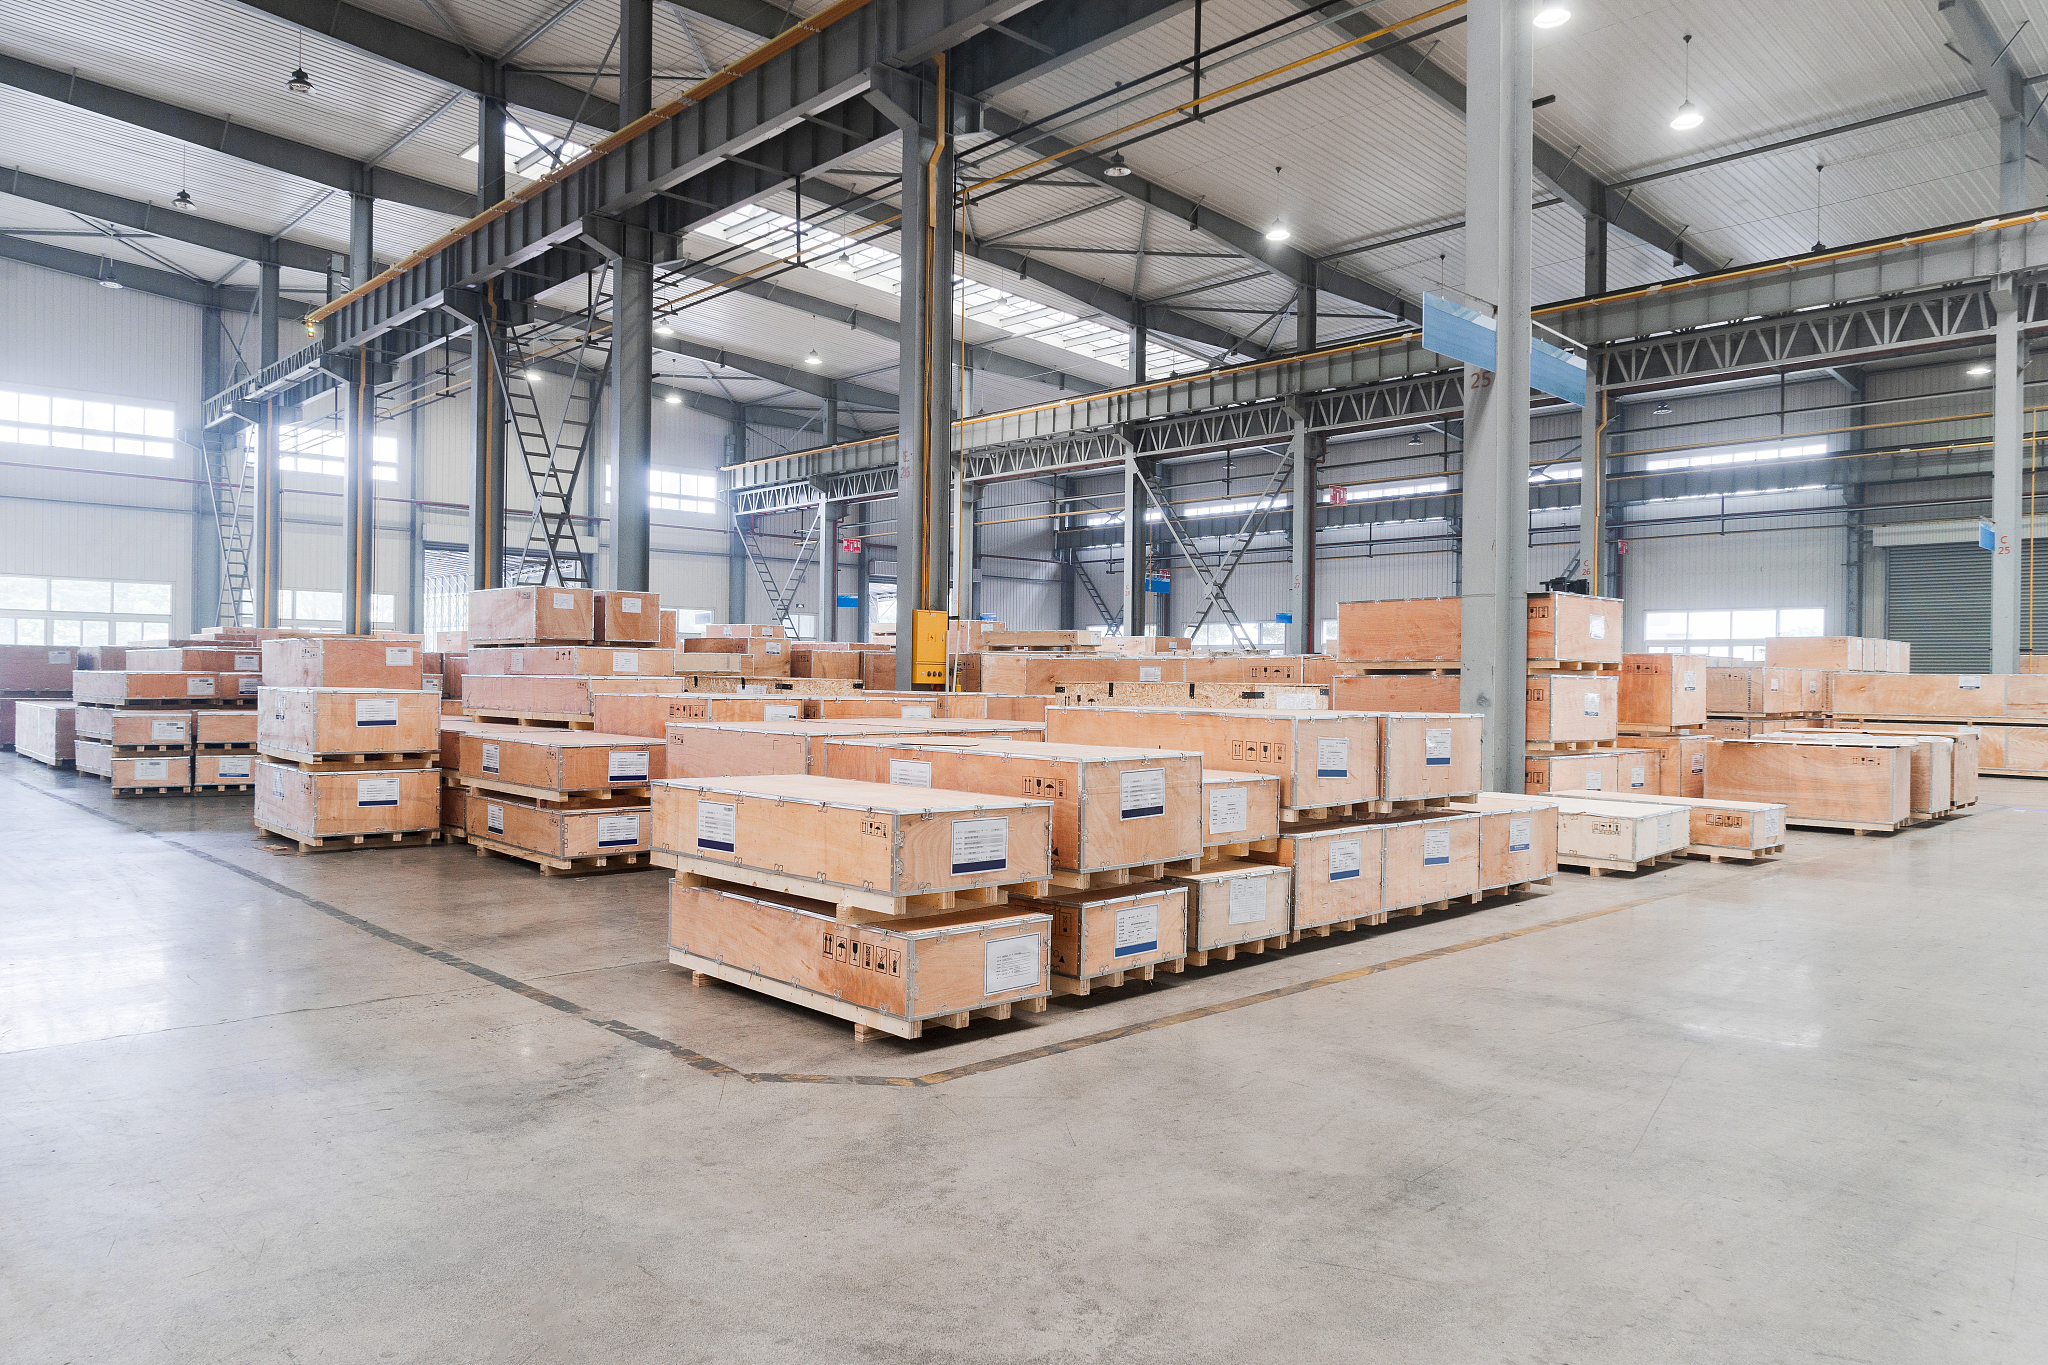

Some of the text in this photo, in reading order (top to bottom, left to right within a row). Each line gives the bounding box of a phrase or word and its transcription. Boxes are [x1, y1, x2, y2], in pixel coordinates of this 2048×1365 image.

[1471, 370, 1491, 389] 25
[2001, 535, 2008, 544] C
[1998, 546, 2010, 555] 25
[1582, 568, 1591, 576] 26
